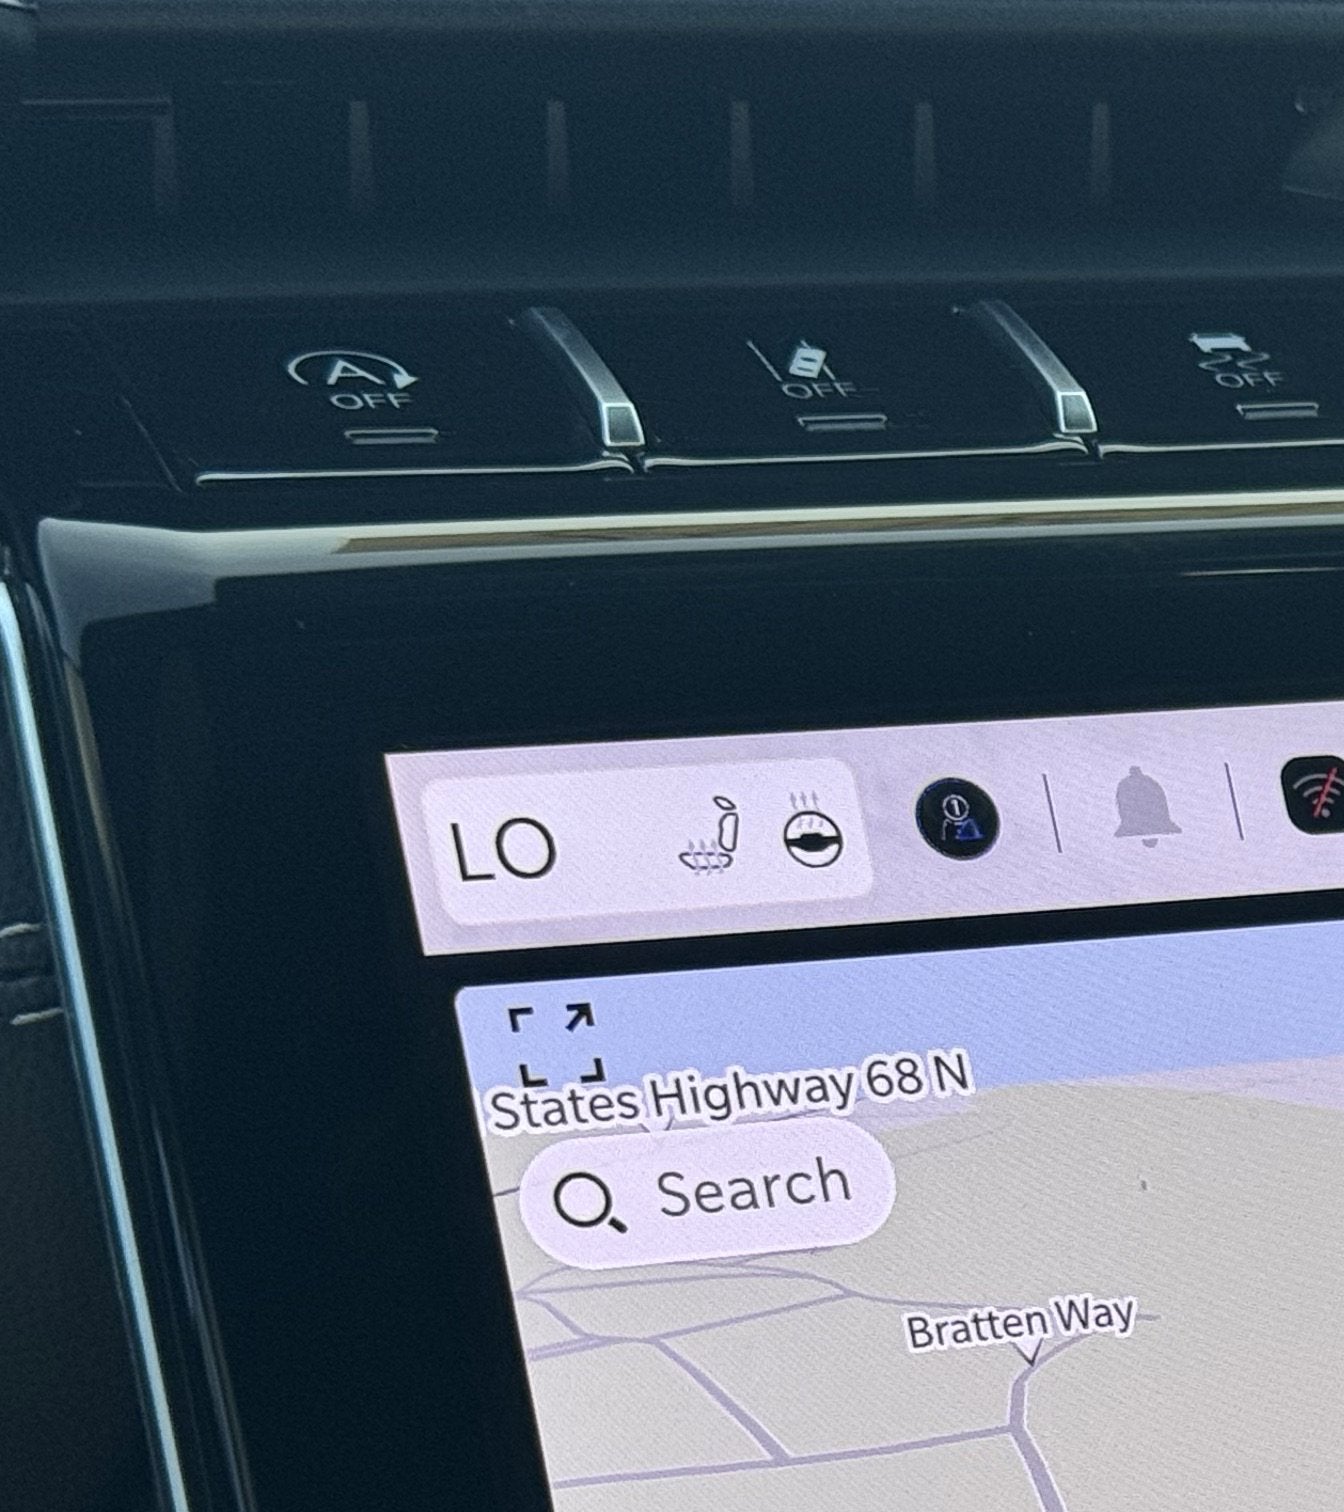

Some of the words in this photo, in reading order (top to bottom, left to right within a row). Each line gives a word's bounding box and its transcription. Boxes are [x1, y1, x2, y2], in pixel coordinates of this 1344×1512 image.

[330, 392, 412, 410] OFF
[782, 382, 856, 399] OFF
[1215, 370, 1284, 388] OFF
[451, 817, 557, 882] LO
[490, 1082, 640, 1131] States
[650, 1068, 855, 1125] Highway
[865, 1058, 923, 1098] 68
[934, 1053, 969, 1091] N
[656, 1156, 852, 1218] Search
[908, 1309, 1049, 1349] Bratten
[1052, 1298, 1136, 1335] Way
